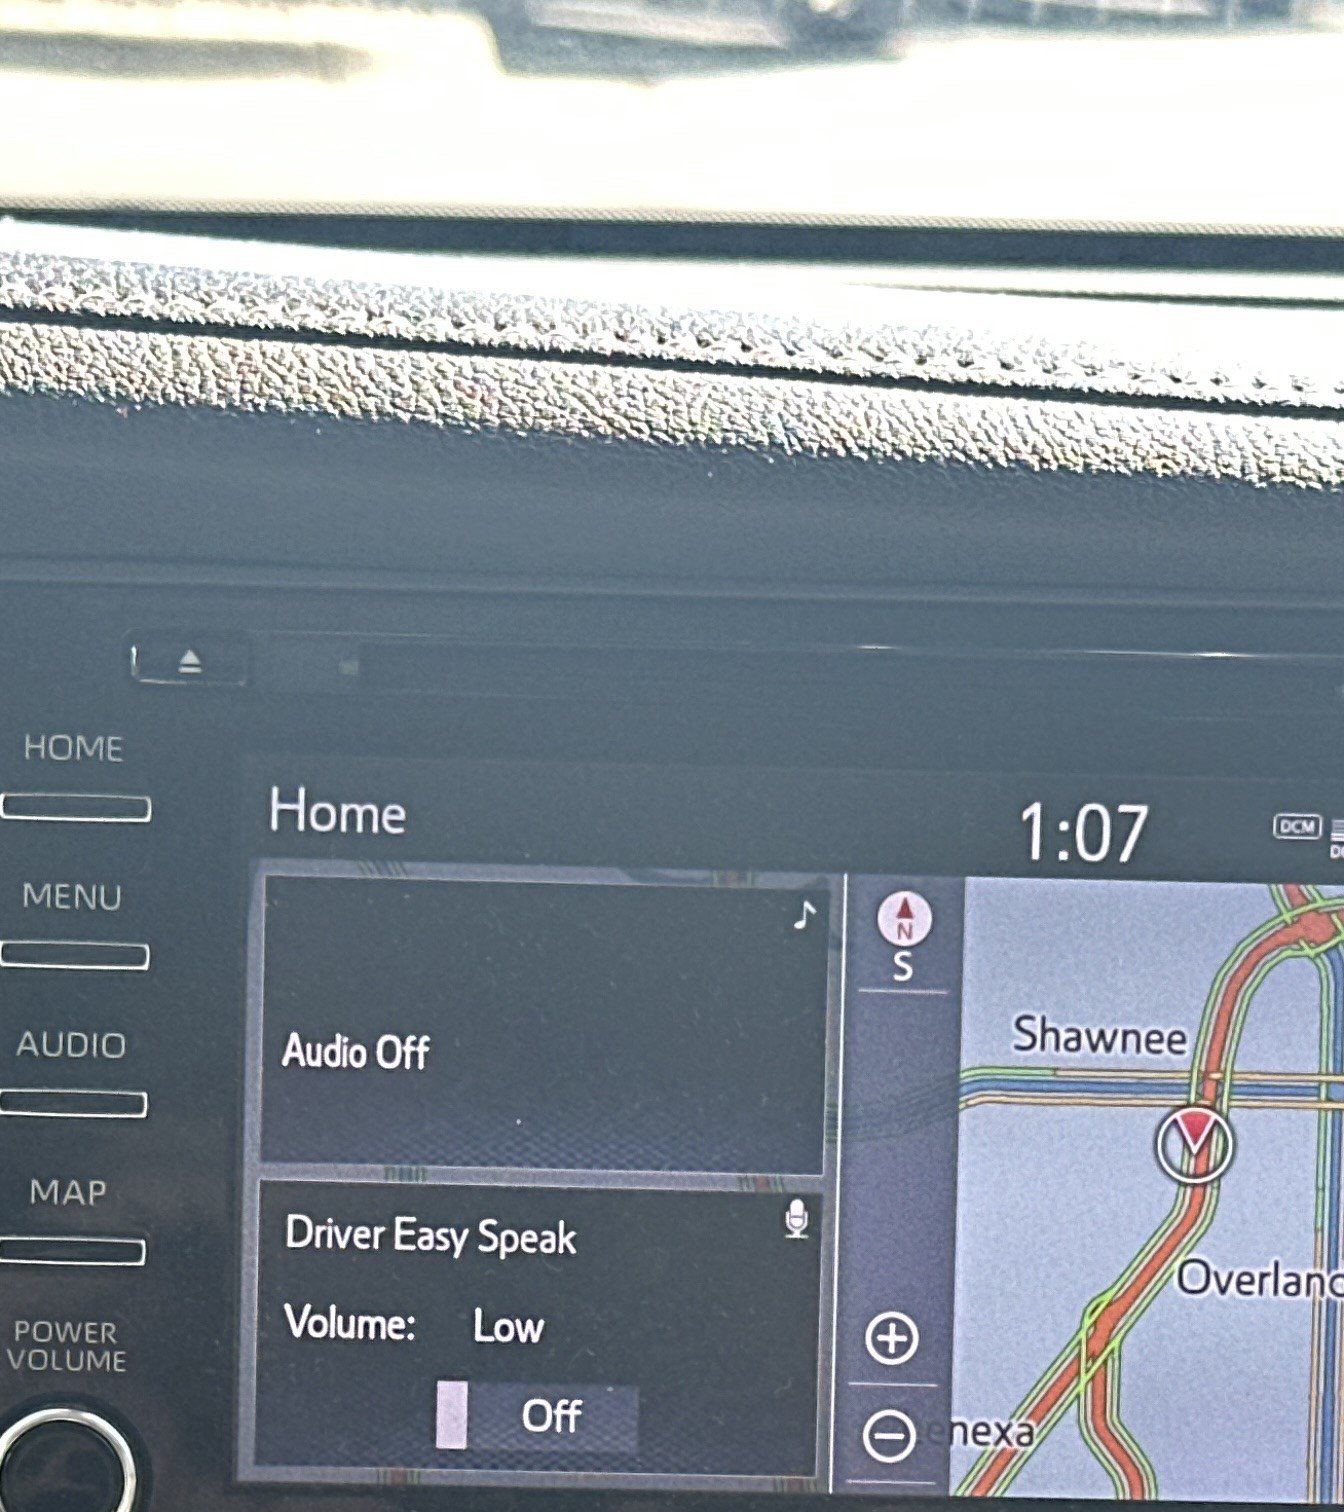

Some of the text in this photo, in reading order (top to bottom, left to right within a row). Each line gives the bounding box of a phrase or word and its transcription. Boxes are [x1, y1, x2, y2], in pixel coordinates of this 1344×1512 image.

[23, 733, 125, 763] HOME
[269, 785, 407, 835] Home
[1020, 801, 1150, 864] 1:07
[1280, 819, 1315, 834] DCM
[22, 882, 122, 911] MENU
[893, 950, 914, 982] S
[15, 1030, 127, 1060] AUDIO
[1012, 1014, 1187, 1056] Shawnee
[281, 1032, 431, 1071] Audio Off
[30, 1178, 108, 1207] MAP
[286, 1214, 577, 1260] Driver Easy Speak
[14, 1320, 117, 1345] POWER
[284, 1303, 545, 1344] Volume: Low
[6, 1349, 127, 1373] VOLUME
[522, 1398, 583, 1434] Off
